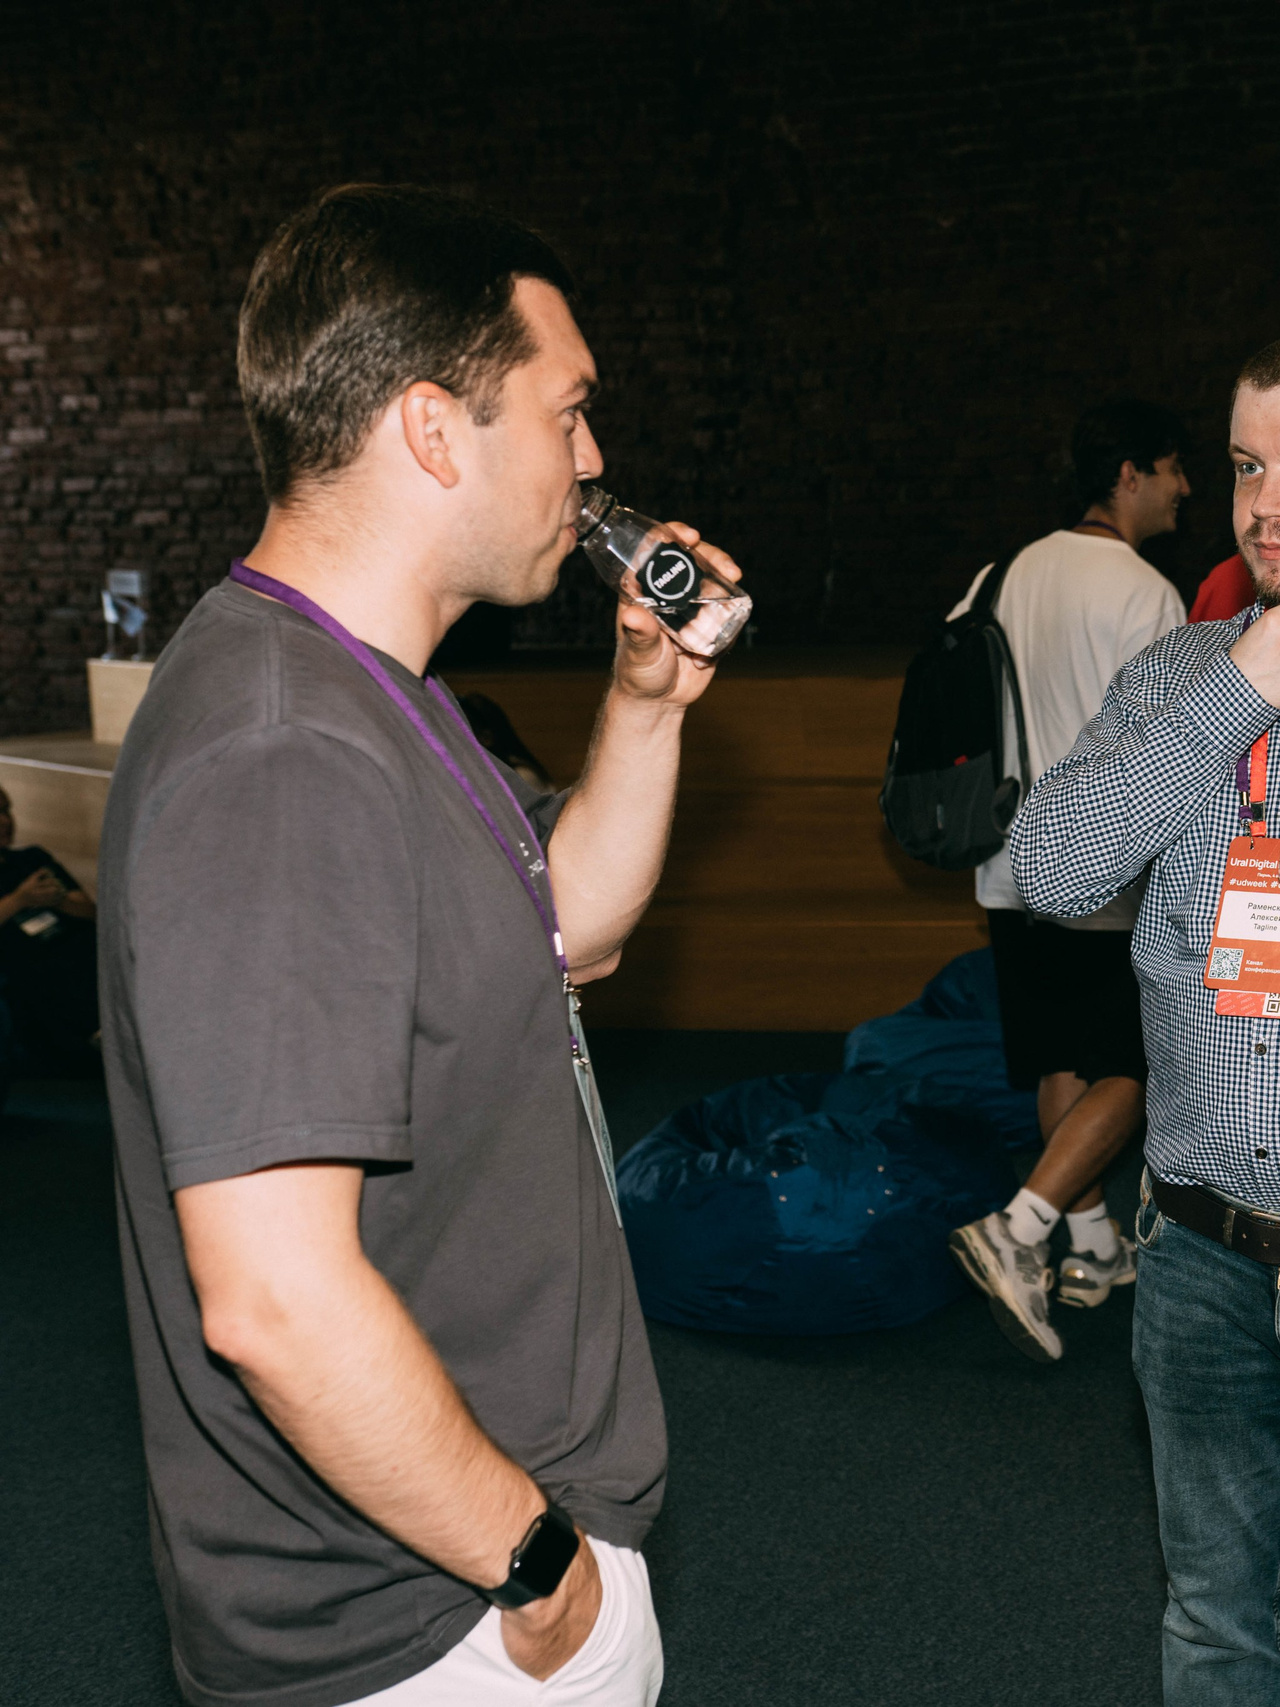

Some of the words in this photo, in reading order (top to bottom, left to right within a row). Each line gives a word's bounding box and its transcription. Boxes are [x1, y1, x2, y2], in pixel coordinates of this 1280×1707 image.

[653, 560, 686, 589] TAGLINE
[1230, 858, 1248, 867] Ural
[1249, 859, 1278, 870] Digital
[1229, 878, 1267, 888] #udweek
[1254, 923, 1277, 931] Tagline
